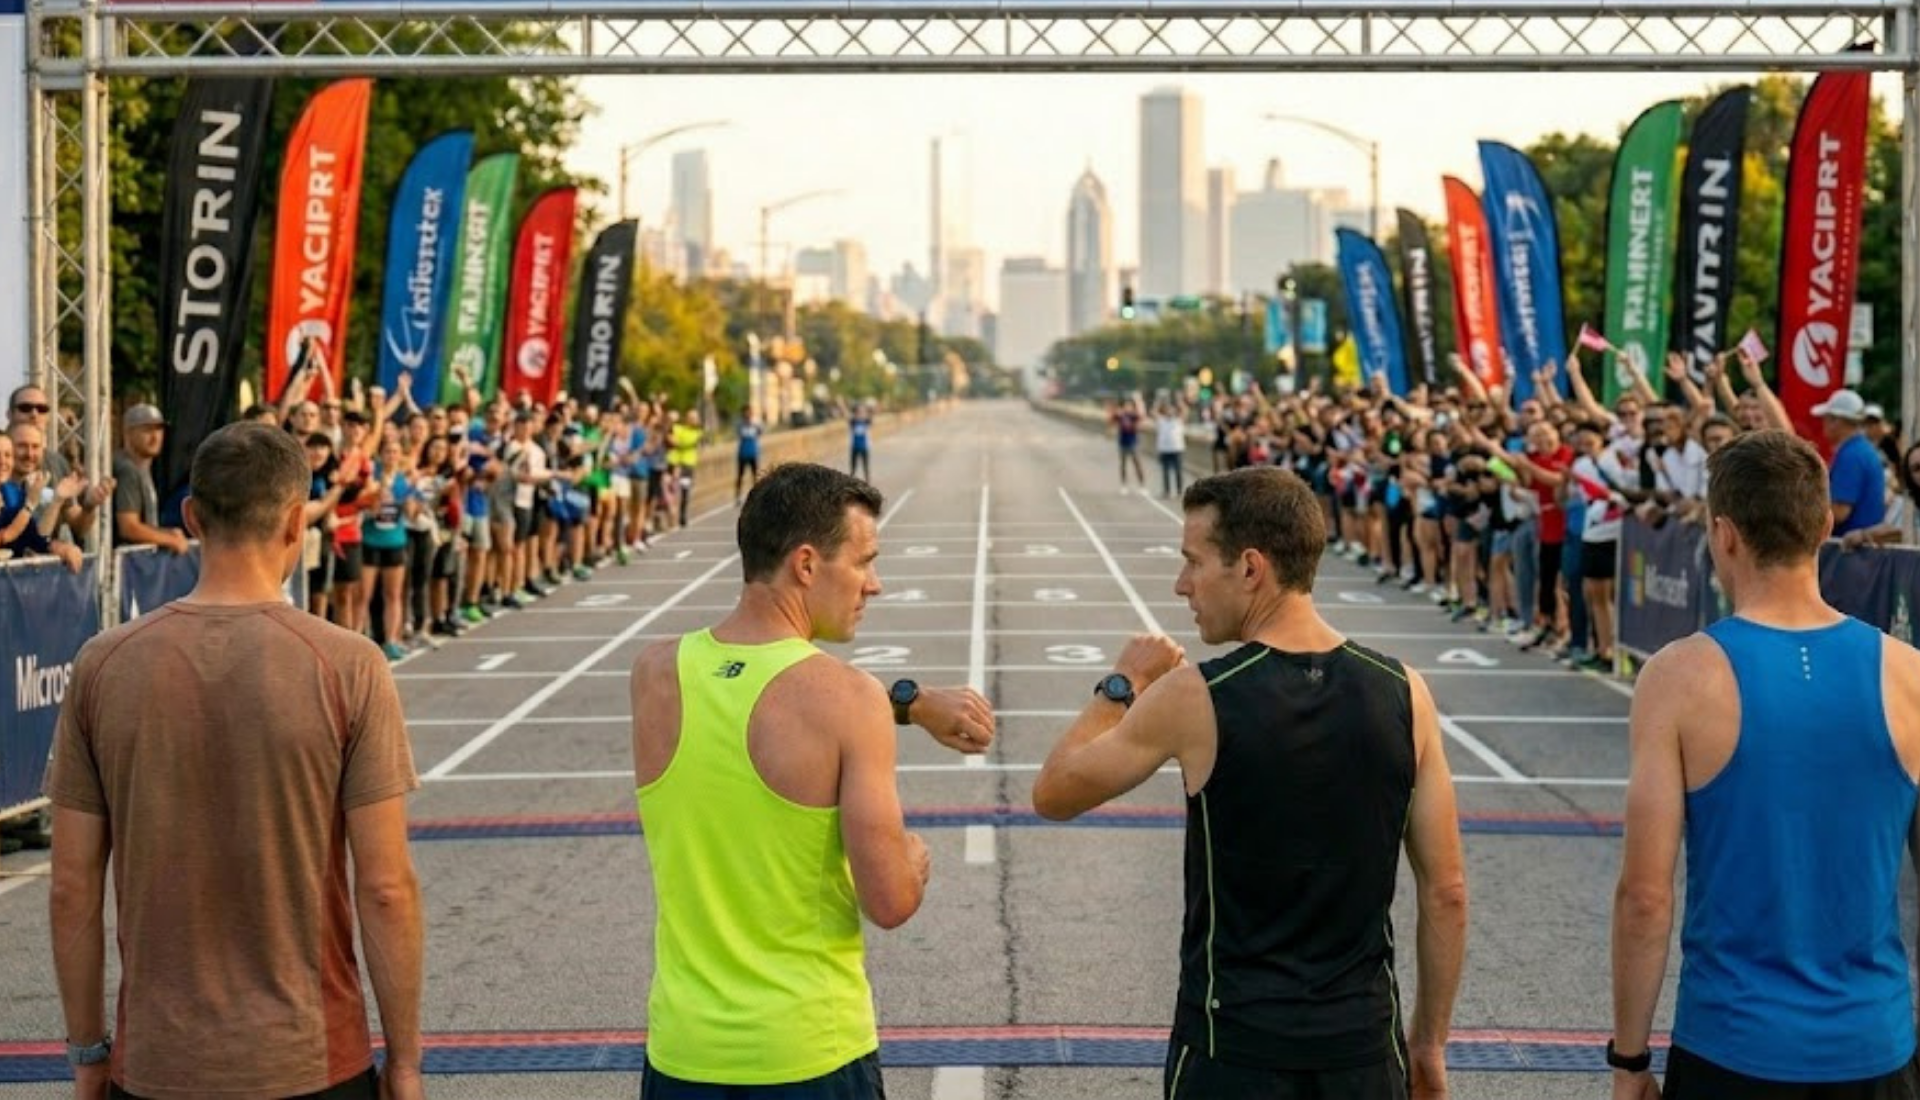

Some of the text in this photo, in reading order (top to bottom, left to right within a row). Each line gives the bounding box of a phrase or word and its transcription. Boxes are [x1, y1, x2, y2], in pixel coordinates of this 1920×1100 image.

[172, 109, 243, 375] STORIN
[298, 143, 336, 314] YACIPRT
[1807, 130, 1841, 316] YACIPRT
[475, 652, 518, 671] 1
[850, 645, 911, 665] 2
[1044, 644, 1106, 664] 3
